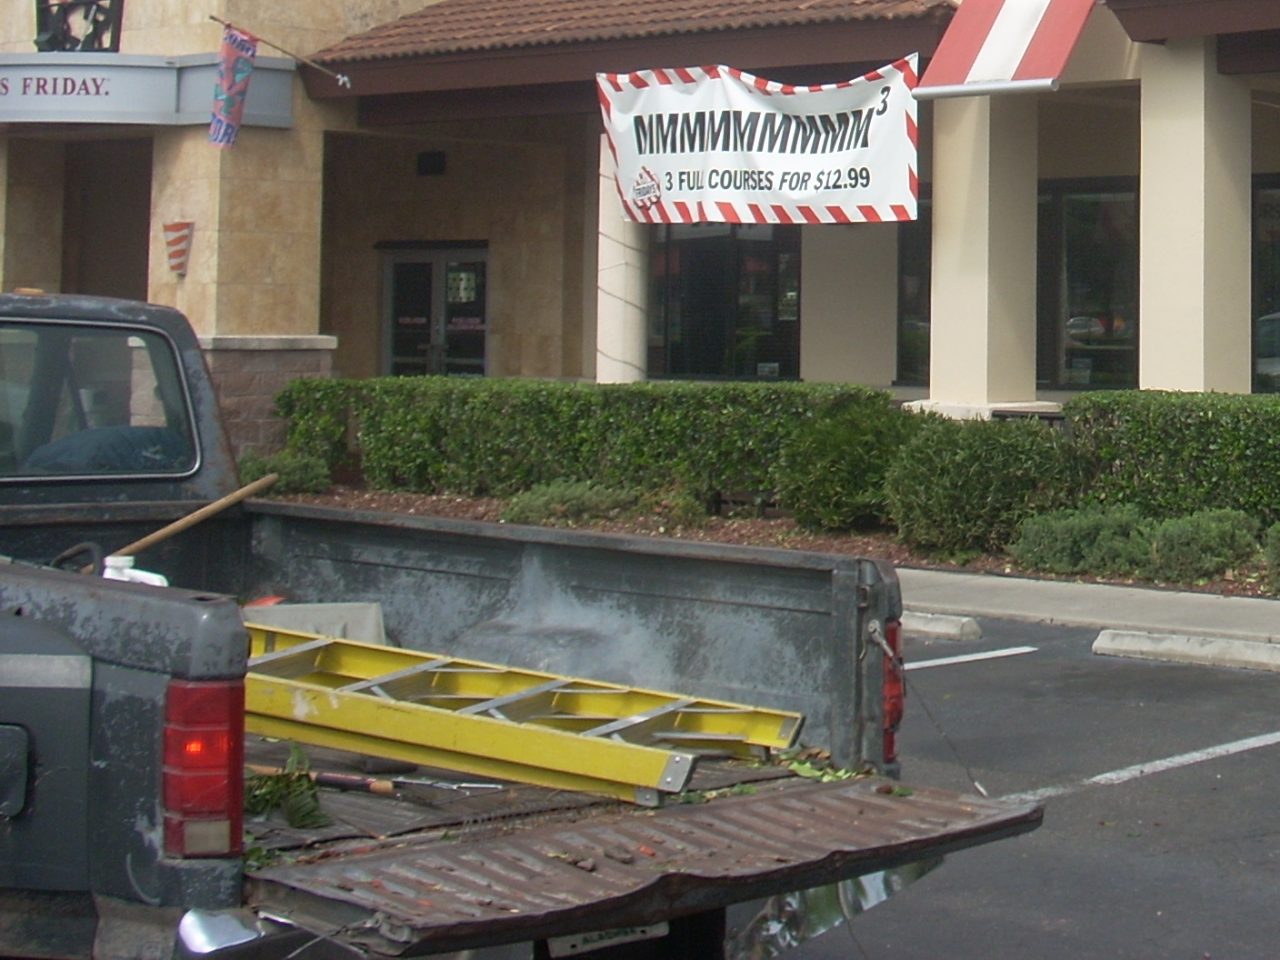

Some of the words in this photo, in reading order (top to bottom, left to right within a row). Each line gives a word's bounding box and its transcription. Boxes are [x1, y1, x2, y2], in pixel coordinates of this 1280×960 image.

[22, 77, 109, 96] FRIDAY.
[665, 171, 673, 191] 3
[708, 169, 773, 190] COURSES
[778, 172, 811, 191] FOR
[814, 167, 870, 191] $12.99
